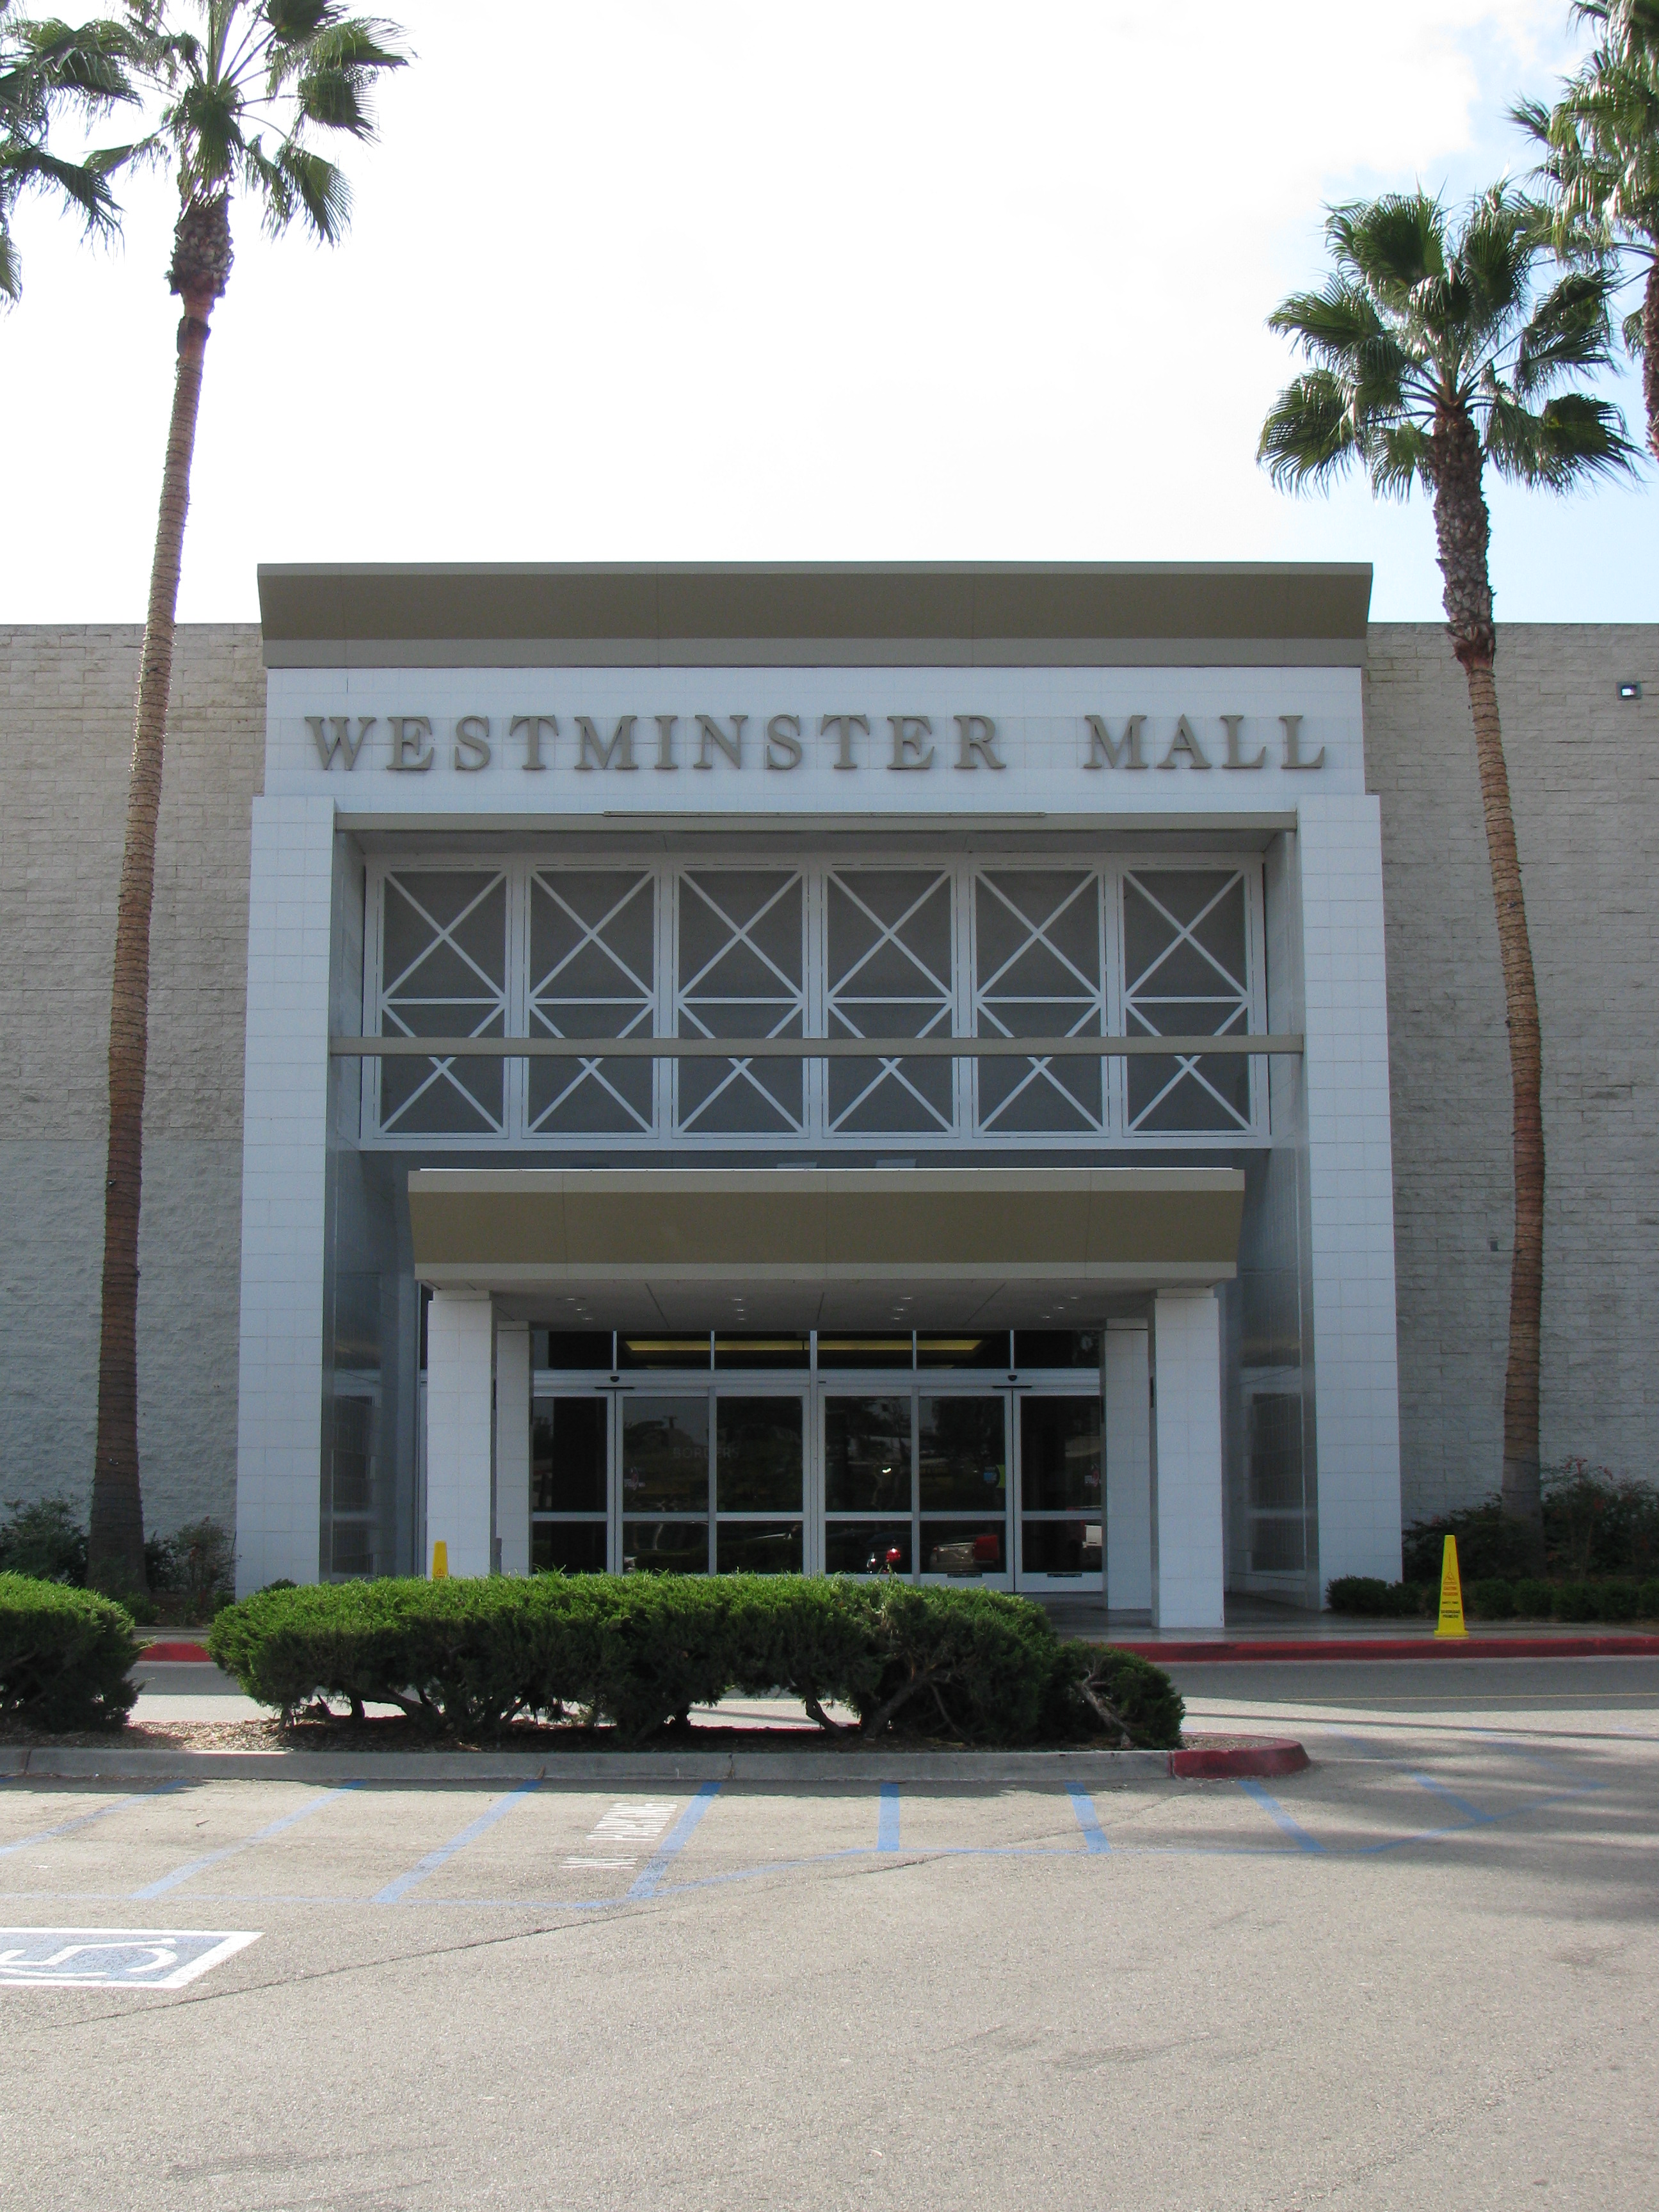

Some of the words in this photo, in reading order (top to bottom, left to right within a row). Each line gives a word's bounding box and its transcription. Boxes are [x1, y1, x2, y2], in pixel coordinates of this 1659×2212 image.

[303, 714, 1007, 770] WESTMINSTER
[1083, 713, 1326, 769] MALL
[585, 1802, 678, 1841] PARKING
